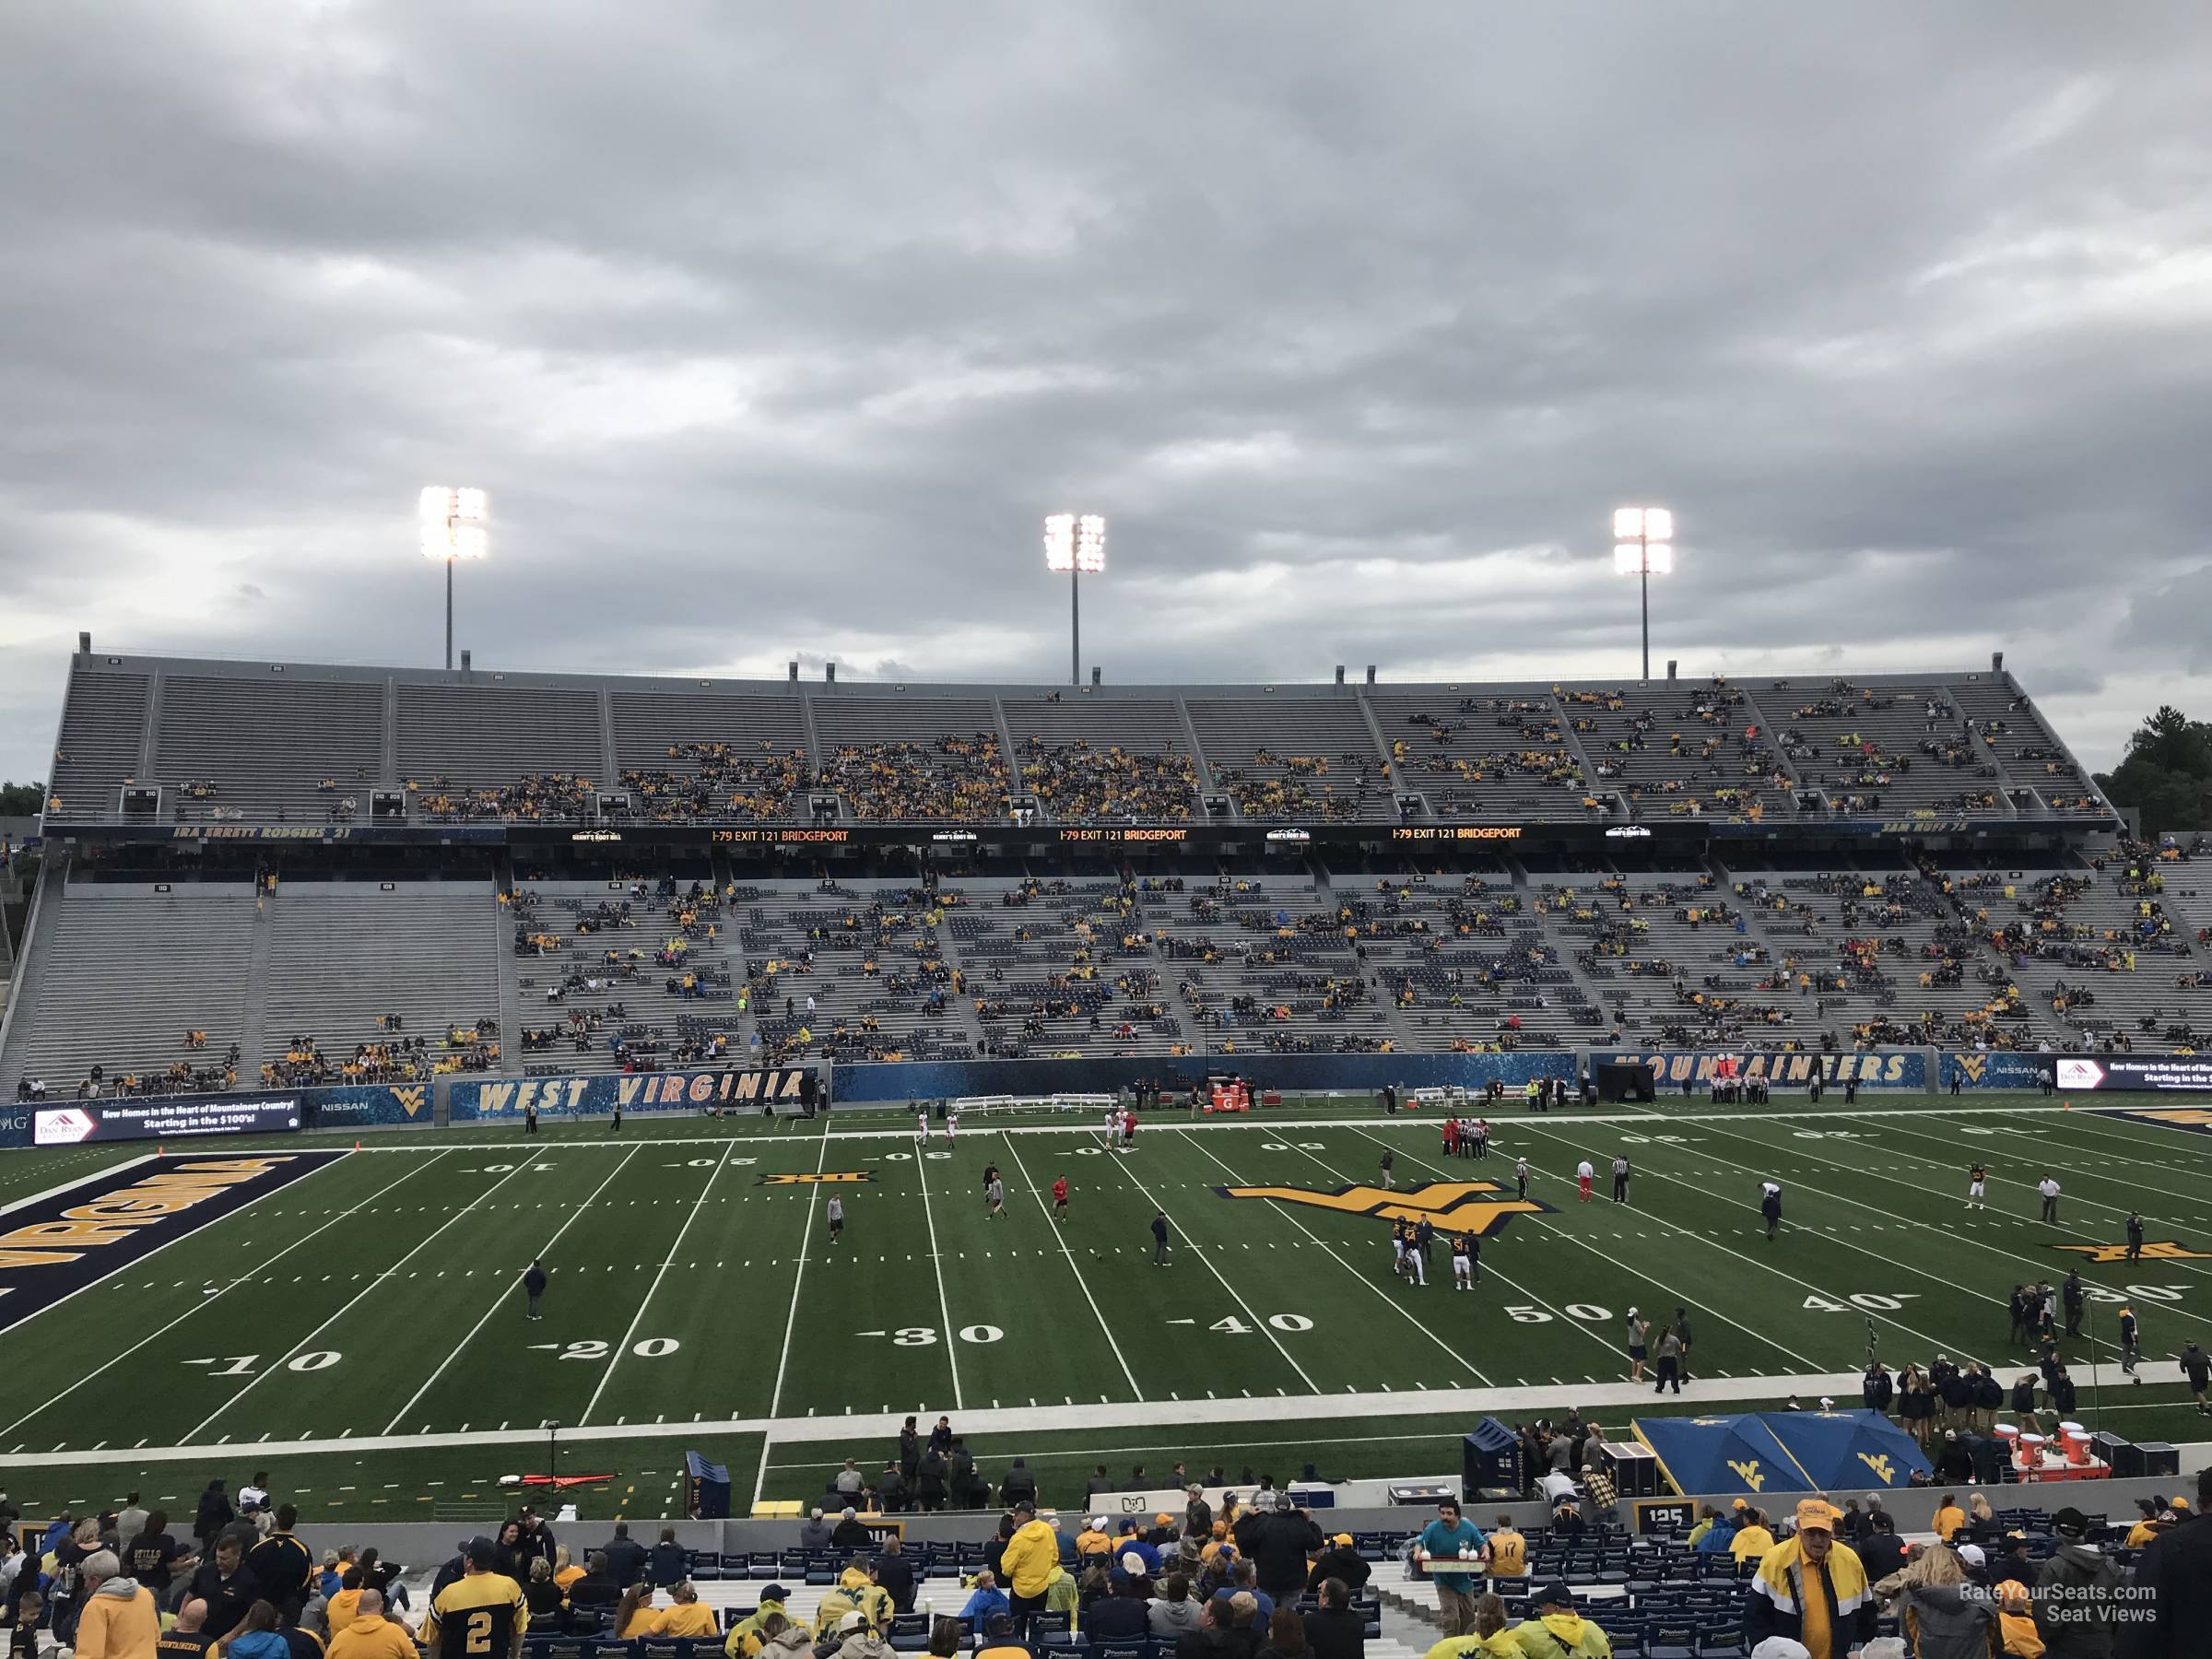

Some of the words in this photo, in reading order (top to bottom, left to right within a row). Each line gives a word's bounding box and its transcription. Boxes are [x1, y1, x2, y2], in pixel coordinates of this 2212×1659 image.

[1881, 823, 1911, 832] SAM
[173, 828, 200, 838] IRA
[261, 828, 326, 838] RODGERS
[334, 828, 350, 838] 21
[712, 831, 733, 841] I-79
[735, 831, 758, 841] EXIT
[760, 831, 778, 841] 121
[782, 831, 849, 841] BRIDGEPORT
[1061, 830, 1078, 841] I-79
[1081, 830, 1103, 841] EXIT
[1105, 830, 1121, 841] 121
[1124, 830, 1187, 841] BRIDGEPORT
[1393, 829, 1412, 839] I-79
[1414, 829, 1435, 839] EXIT
[1438, 829, 1454, 839] 121
[1457, 829, 1521, 839] BRIDGEPORT
[2171, 1064, 2190, 1072] Heart
[2144, 1074, 2181, 1083] Starting
[2182, 1074, 2191, 1082] in
[2192, 1074, 2207, 1082] the
[479, 1079, 588, 1112] WEST
[618, 1071, 803, 1104] VIRGINIA
[102, 1110, 120, 1118] New
[122, 1109, 149, 1117] Homes
[160, 1107, 174, 1115] the
[176, 1106, 198, 1114] Heart
[200, 1105, 209, 1113] of
[209, 1103, 260, 1113] Mountaineer
[261, 1100, 294, 1111] Country!
[322, 1102, 369, 1112] NISSAN
[1223, 1099, 1233, 1109] G
[144, 1118, 186, 1128] Starting
[189, 1117, 198, 1125] in
[200, 1116, 218, 1125] the
[220, 1114, 255, 1124] $100's!
[1453, 1241, 1463, 1252] 51
[2033, 1445, 2043, 1455] G
[2082, 1444, 2090, 1454] G
[1505, 1542, 1516, 1558] 17
[466, 1612, 493, 1653] 2
